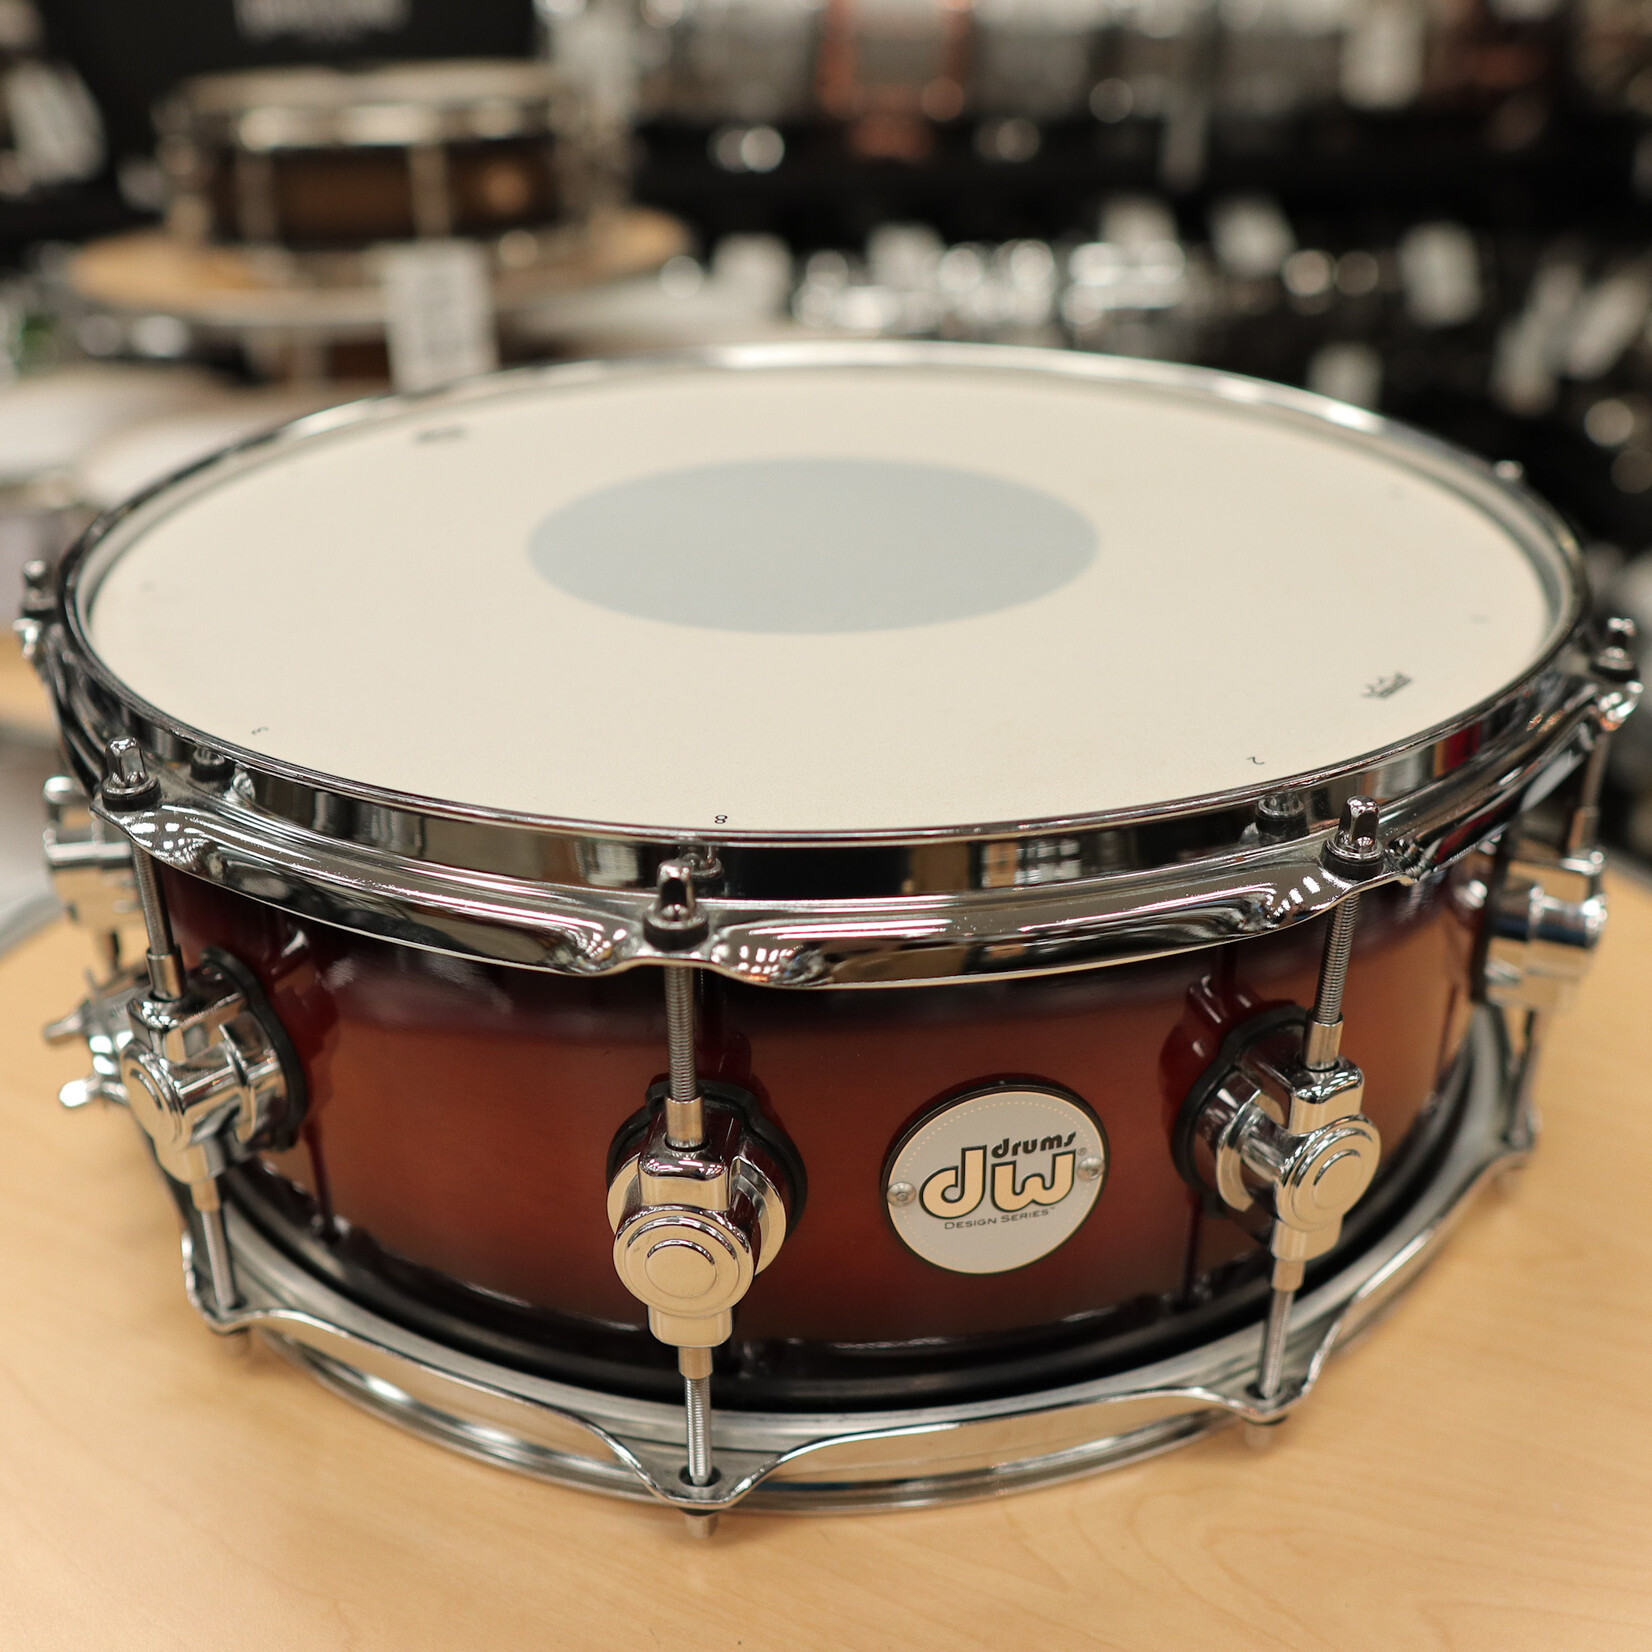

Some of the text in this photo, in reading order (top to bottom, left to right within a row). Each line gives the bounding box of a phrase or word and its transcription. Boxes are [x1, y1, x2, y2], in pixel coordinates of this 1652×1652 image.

[714, 814, 728, 825] 8
[991, 1131, 1077, 1159] drums
[918, 1144, 1077, 1220] dw
